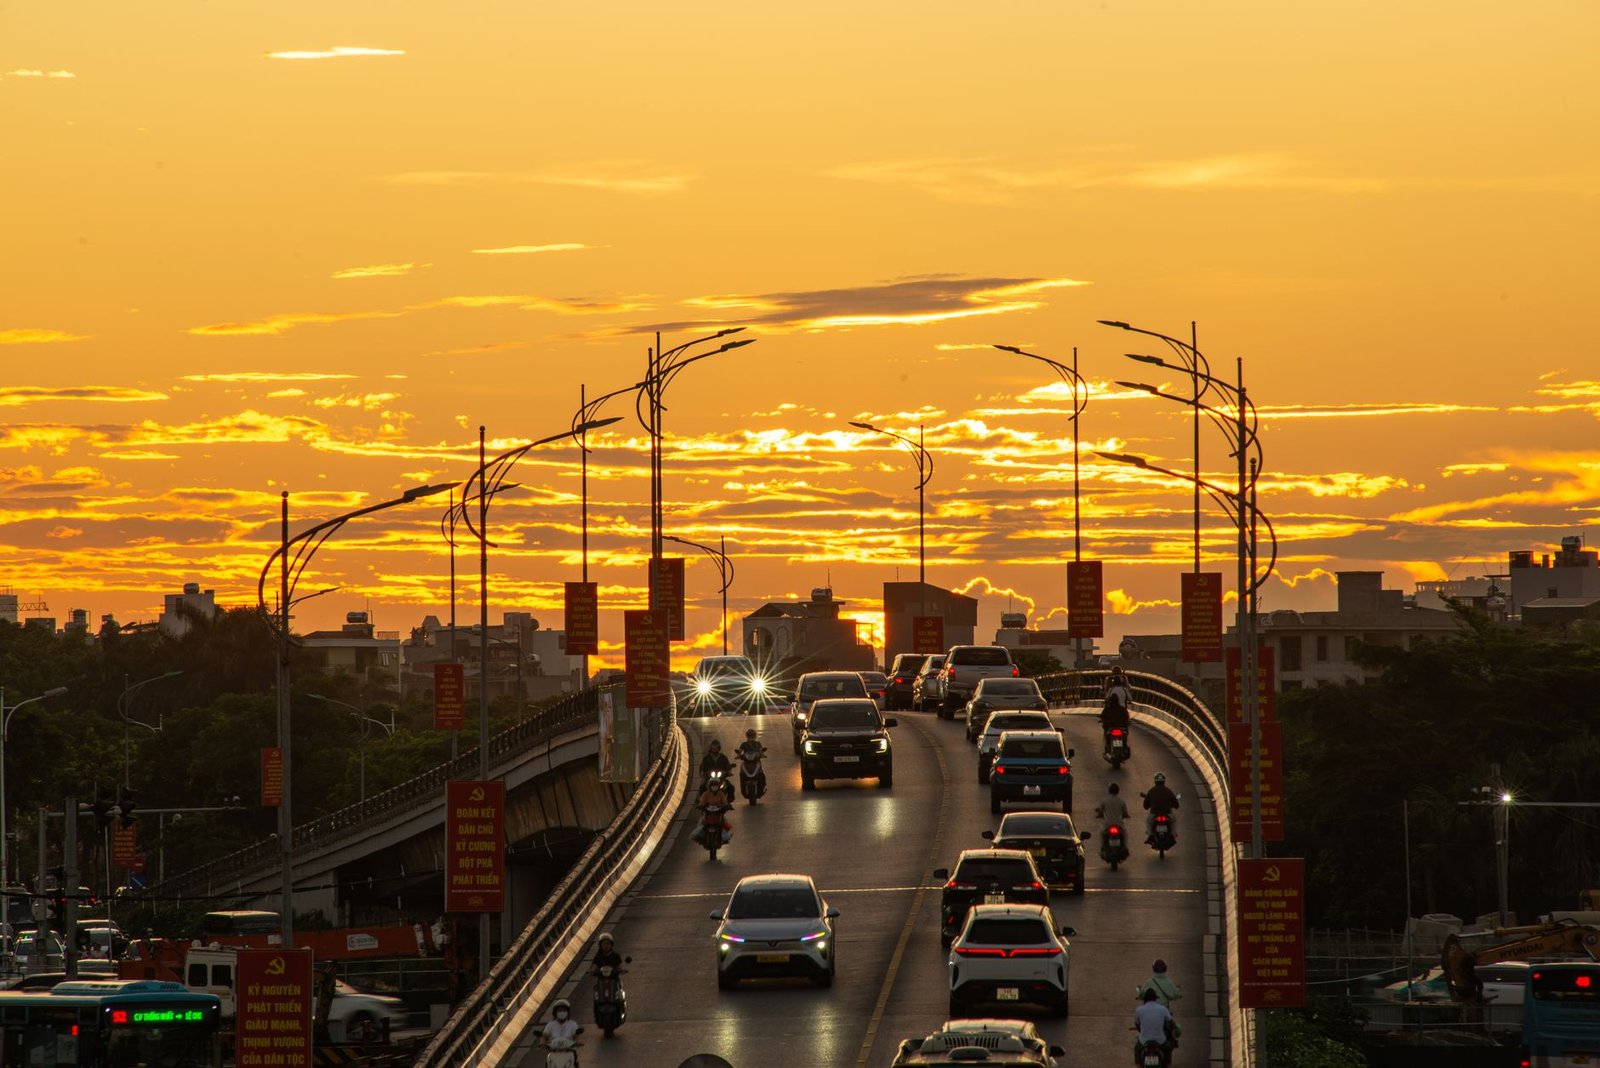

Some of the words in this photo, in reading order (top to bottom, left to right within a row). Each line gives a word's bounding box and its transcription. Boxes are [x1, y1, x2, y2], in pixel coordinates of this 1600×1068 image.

[456, 806, 479, 818] ĐOÀN
[480, 805, 496, 818] KẾT
[458, 822, 476, 835] DÂN
[477, 822, 494, 835] CHỦ
[456, 838, 467, 851] KỶ
[459, 856, 475, 870] ĐỘT
[476, 855, 493, 868] PHÁ
[452, 873, 474, 885] PHÁT
[475, 871, 499, 885] TRIỂN
[1499, 942, 1545, 959] HYUNDAI
[248, 982, 260, 996] KỶ
[262, 984, 301, 996] NGUYÊN
[247, 1001, 272, 1013] PHÁT
[273, 999, 302, 1013] TRIỂN
[270, 1019, 302, 1032] MẠNH,
[243, 1037, 271, 1049] THỊNH
[273, 1036, 305, 1049] VƯỢNG
[242, 1051, 262, 1065] CỦA
[263, 1053, 284, 1065] DÂN
[285, 1053, 305, 1067] TỘC
